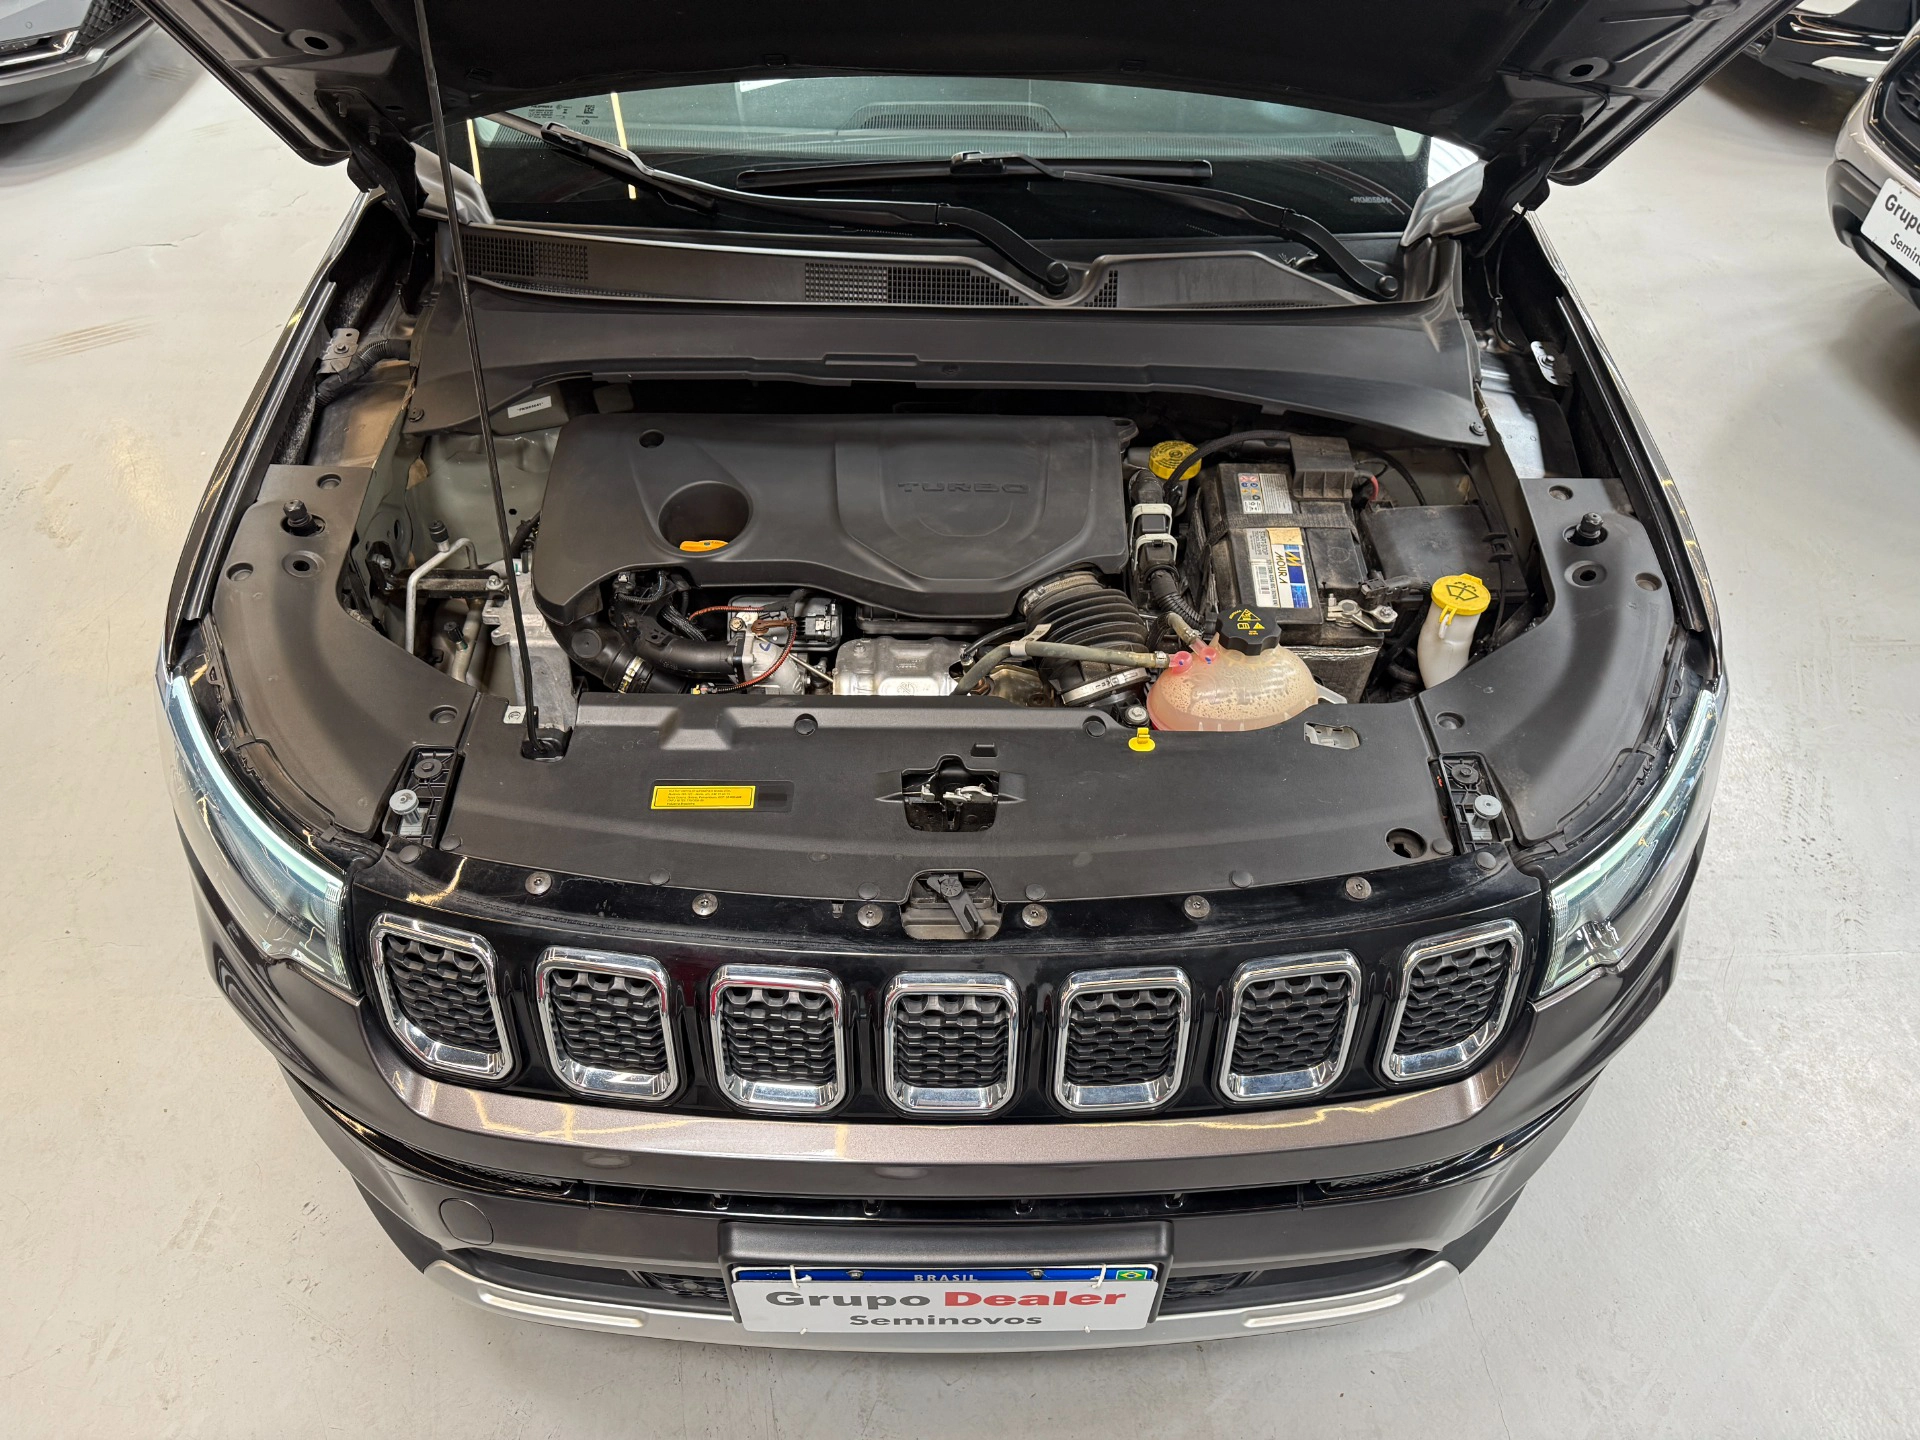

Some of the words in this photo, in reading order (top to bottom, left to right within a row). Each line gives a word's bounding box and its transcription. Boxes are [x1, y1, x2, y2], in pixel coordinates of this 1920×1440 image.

[1890, 233, 1920, 267] Semin
[897, 482, 1030, 494] TURBO
[1274, 551, 1289, 584] MOURA
[766, 1291, 931, 1310] Grupo
[944, 1291, 1127, 1307] Dealer
[849, 1314, 1043, 1326] Seminovos
